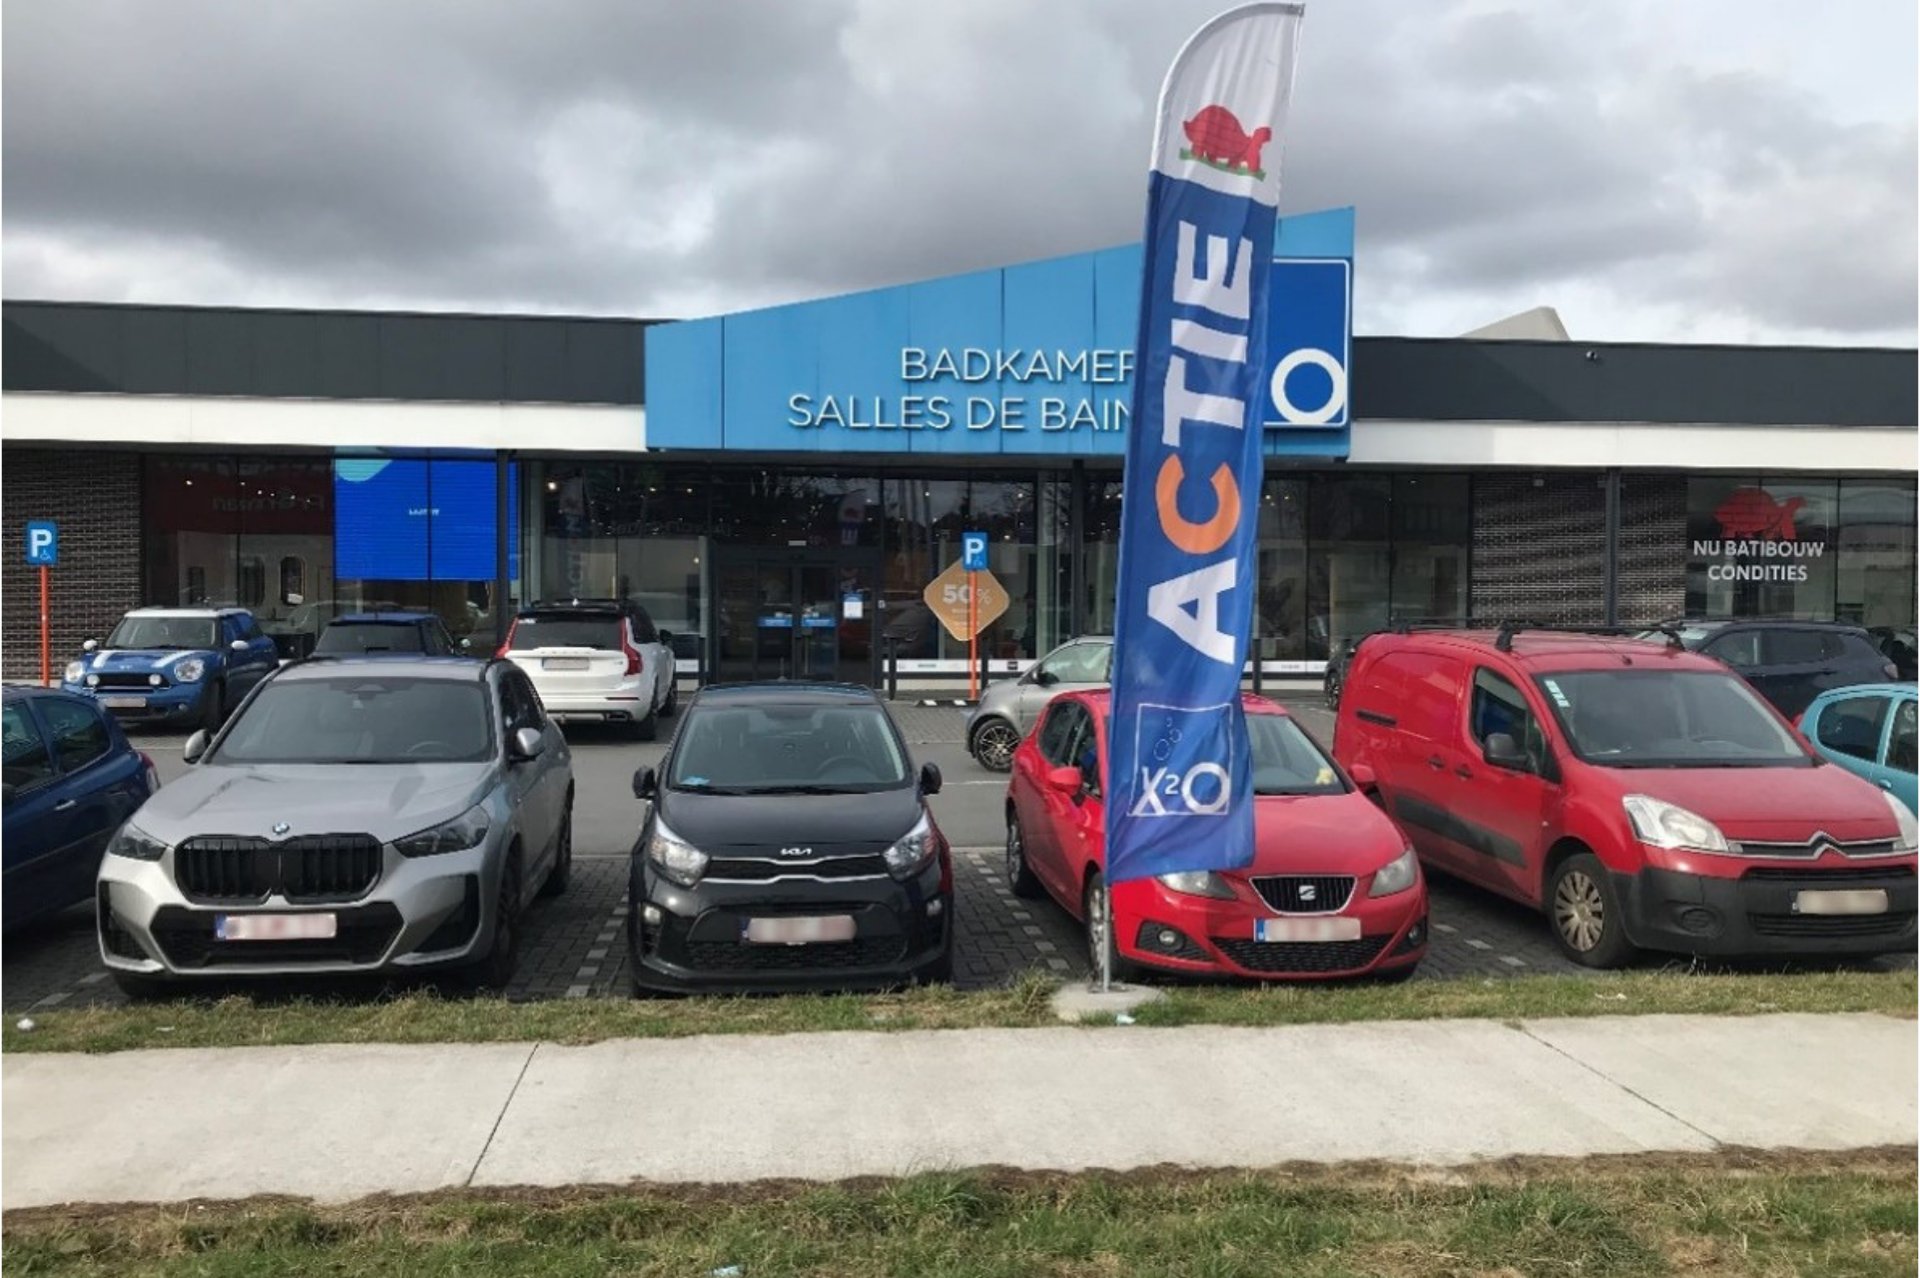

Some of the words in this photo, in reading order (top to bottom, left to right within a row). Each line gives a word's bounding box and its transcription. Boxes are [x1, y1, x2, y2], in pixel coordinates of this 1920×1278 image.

[787, 393, 951, 429] SALLES
[966, 397, 1025, 430] DE
[1147, 219, 1253, 665] ACTIE
[31, 529, 52, 558] P
[965, 538, 984, 564] P
[1693, 540, 1721, 556] NU
[1725, 540, 1825, 557] BATIBOUW
[1707, 565, 1808, 581] CONDITIES
